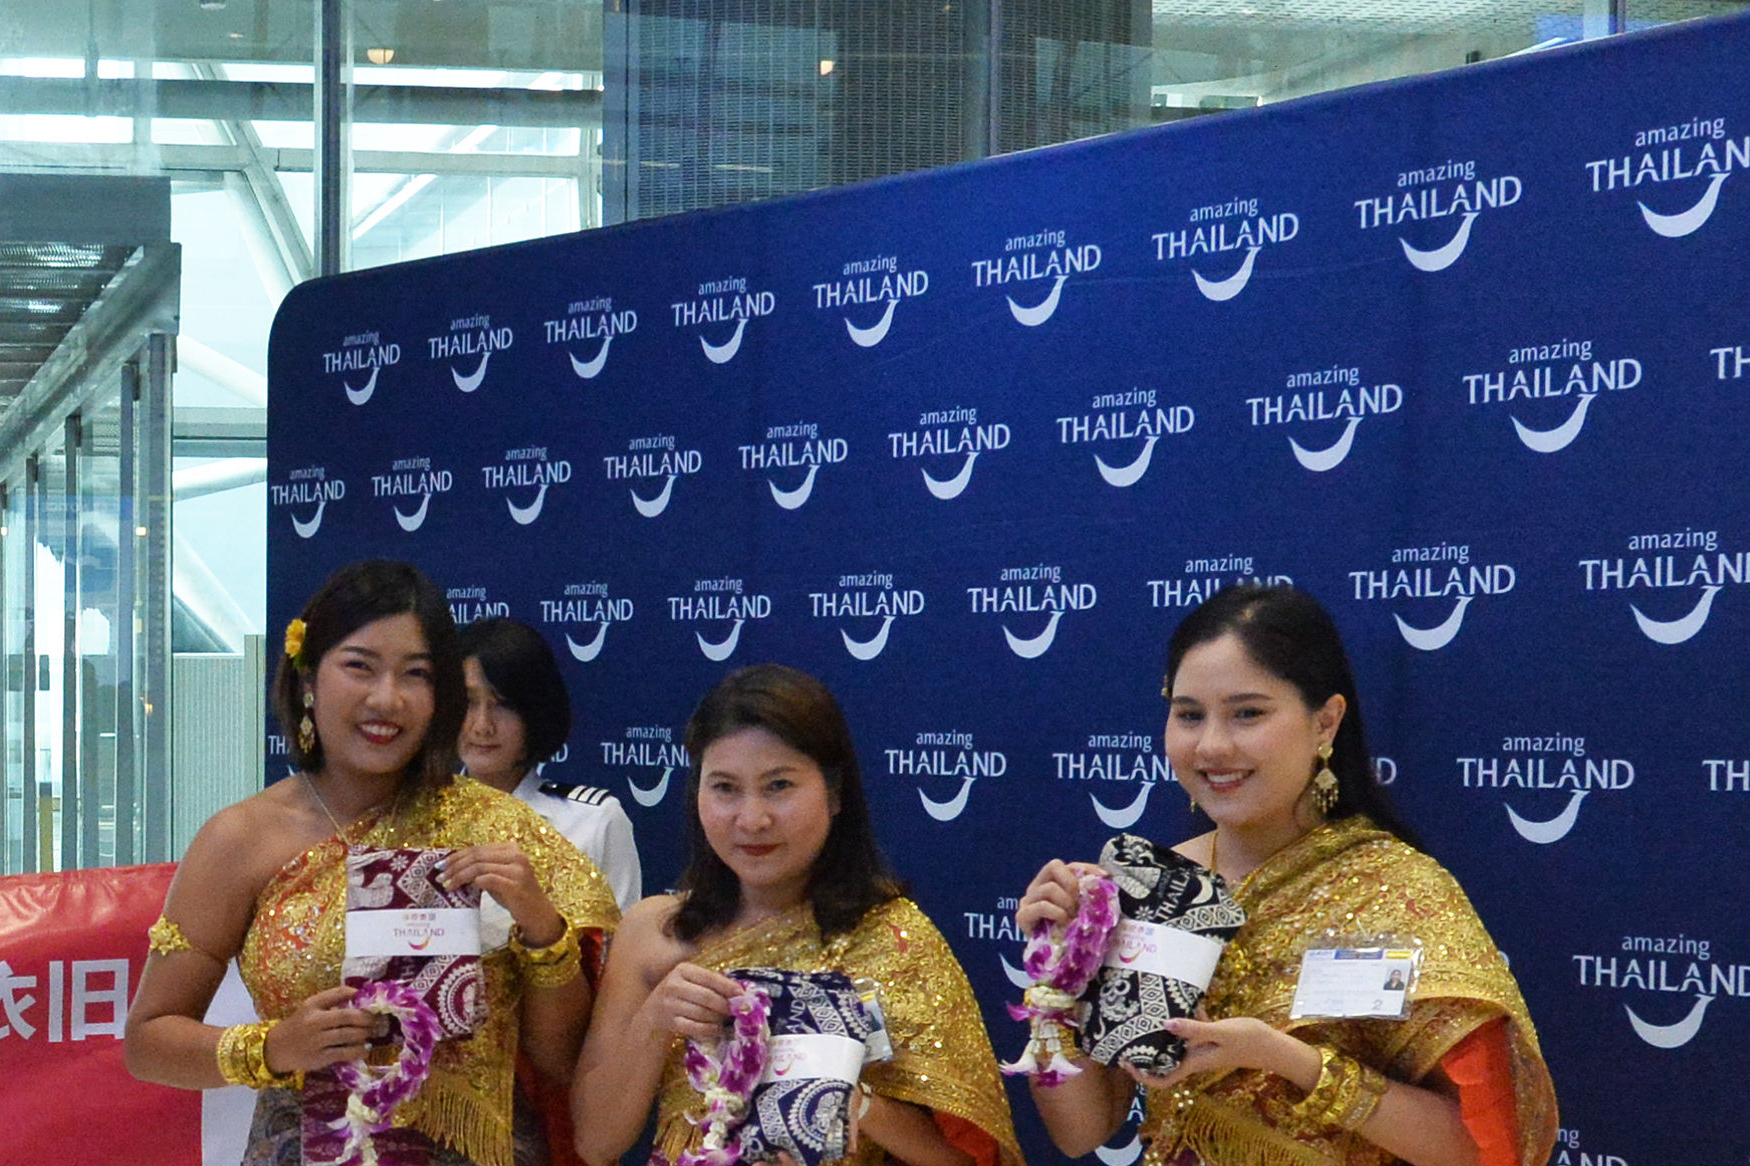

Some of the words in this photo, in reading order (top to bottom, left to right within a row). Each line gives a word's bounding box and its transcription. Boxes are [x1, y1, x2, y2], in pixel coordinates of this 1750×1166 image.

[1635, 117, 1726, 147] amazing
[1397, 160, 1475, 187] amazing
[1585, 136, 1750, 192] THAILAN
[1190, 198, 1258, 222] amazing
[1355, 176, 1522, 229] THAILAND
[1005, 229, 1065, 251] amazing
[1152, 213, 1299, 260] THAILAND
[843, 254, 897, 275] amazing
[972, 245, 1101, 287] THAILAND
[698, 276, 746, 296] amazing
[813, 271, 929, 308] THAILAND
[568, 296, 612, 314] amazing
[672, 292, 774, 326] THAILAND
[451, 313, 490, 330] amazing
[544, 311, 637, 343] THAILAND
[343, 330, 380, 347] amazing
[428, 328, 513, 359] THAILAND
[323, 344, 400, 373] THAILAND
[1509, 339, 1592, 364] amazing
[1287, 365, 1359, 387] amazing
[1463, 359, 1641, 404] THAILAND
[1093, 387, 1156, 408] amazing
[1246, 384, 1403, 425] THAILAND
[920, 406, 976, 425] amazing
[1057, 406, 1194, 443] THAILAND
[629, 434, 674, 449] amazing
[767, 421, 818, 439] amazing
[888, 424, 1010, 458] THAILAND
[392, 456, 430, 471] amazing
[506, 446, 547, 462] amazing
[604, 450, 702, 479] THAILAND
[739, 439, 847, 469] THAILAND
[290, 465, 325, 480] amazing
[371, 472, 452, 496] THAILAND
[482, 461, 571, 488] THAILAND
[271, 480, 345, 505] THAILAND
[1628, 528, 1718, 551] amazing
[1185, 554, 1254, 574] amazing
[1392, 541, 1470, 564] amazing
[839, 571, 892, 589] amazing
[1001, 563, 1061, 582] amazing
[1348, 564, 1516, 599] THAILAND
[1578, 552, 1750, 590] THAILAN
[446, 585, 486, 600] amazing
[564, 581, 608, 597] amazing
[695, 576, 742, 594] amazing
[1147, 576, 1293, 607] THAI
[540, 599, 633, 622] THAILAND
[667, 595, 770, 620] THAILAND
[809, 590, 924, 616] THAILAND
[967, 584, 1097, 613] THAILAND
[449, 602, 509, 624] AILAND
[626, 725, 672, 742] amazing
[916, 730, 973, 749] amazing
[1088, 731, 1153, 751] amazing
[1503, 733, 1585, 756] amazing
[600, 742, 691, 768] THAILAN
[885, 750, 1007, 777] THAILAND
[1052, 753, 1178, 782] THAILAN
[1457, 758, 1634, 789] THAILAND
[964, 912, 1028, 942] THAI
[1621, 935, 1710, 960] amazing
